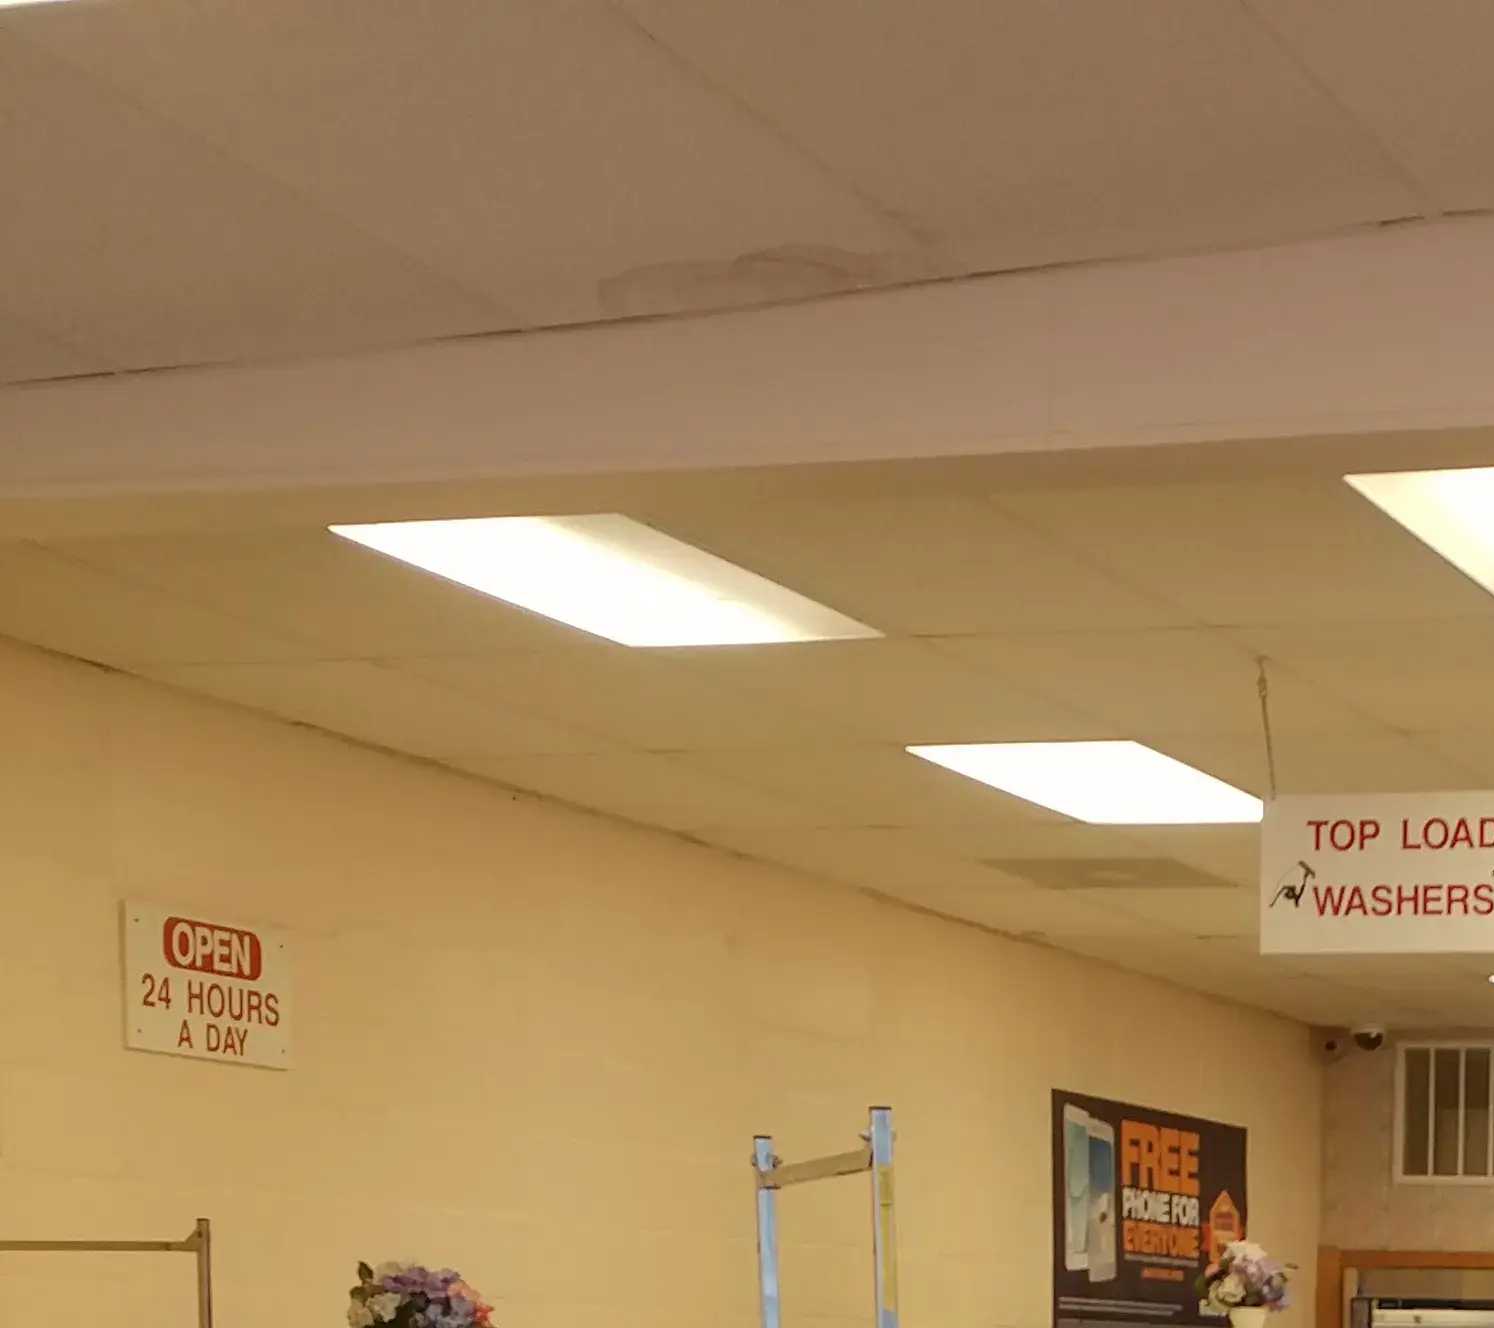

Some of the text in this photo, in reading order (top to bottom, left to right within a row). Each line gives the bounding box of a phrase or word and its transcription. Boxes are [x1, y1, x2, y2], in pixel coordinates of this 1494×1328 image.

[1307, 820, 1381, 850] TOP
[1313, 884, 1494, 917] WASHERS
[172, 922, 251, 976] OPEN
[142, 973, 280, 1027] 24 HOURS
[178, 1019, 248, 1057] A DAY
[1121, 1122, 1200, 1196] FREE
[1122, 1187, 1200, 1227] PHONE FOR
